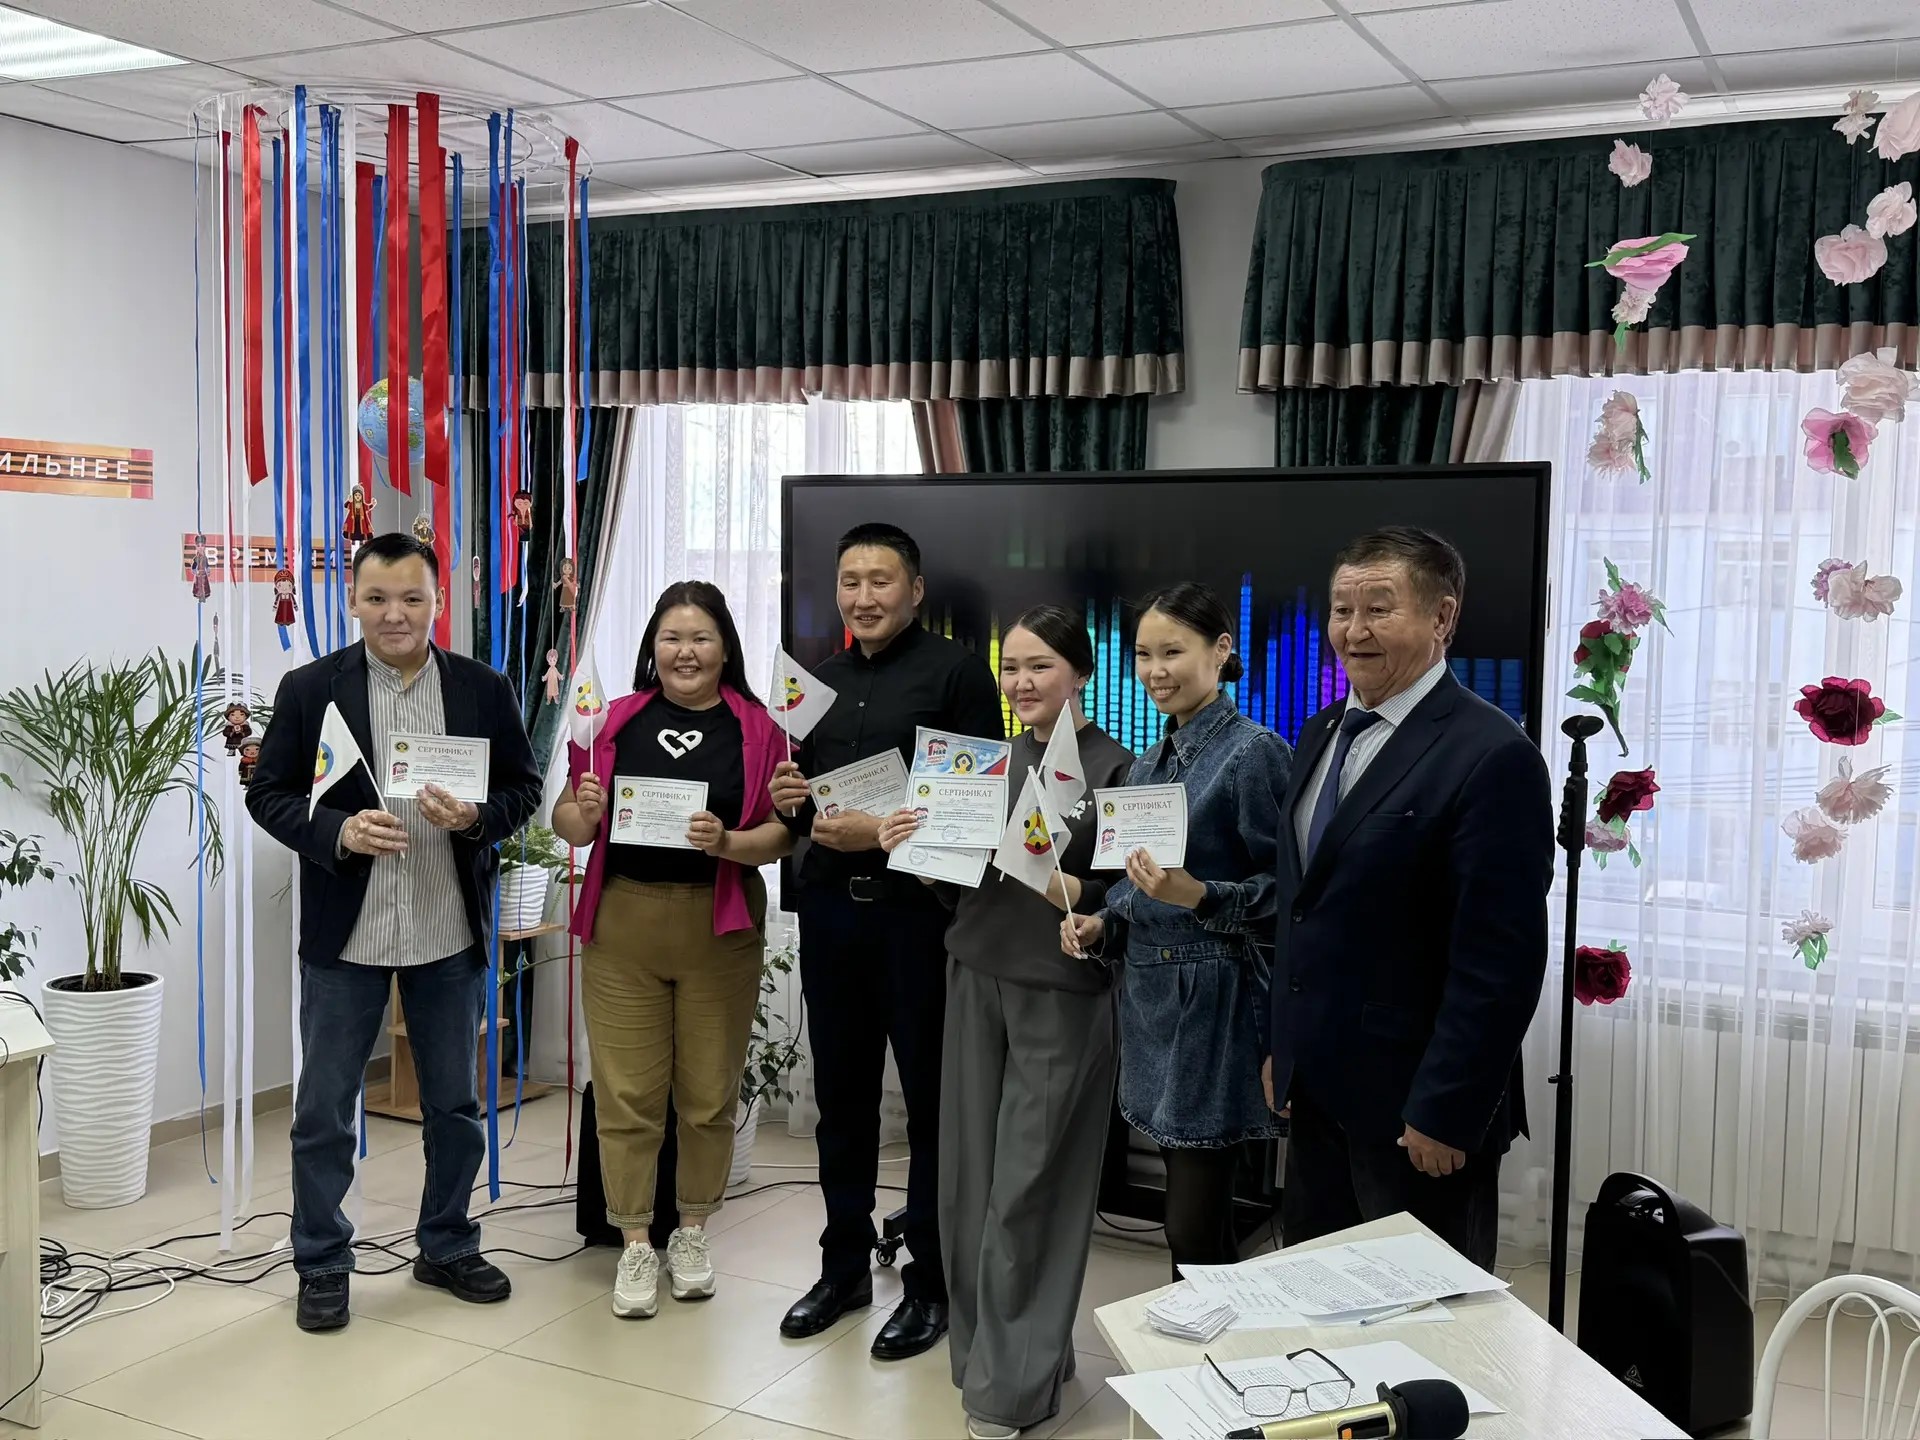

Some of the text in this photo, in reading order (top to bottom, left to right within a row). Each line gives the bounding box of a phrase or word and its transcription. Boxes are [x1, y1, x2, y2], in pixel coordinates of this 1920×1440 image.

[0, 452, 129, 480] ИЛЬНЕЕ
[417, 745, 474, 756] СЕРТИФИКАТ
[838, 764, 889, 788] СЕРТИФИКАТ
[641, 790, 692, 801] СЕРТИФИКАТ
[938, 788, 993, 798] СЕРТИФИКАТ
[1122, 800, 1173, 811] СЕРТИФИКАТ
